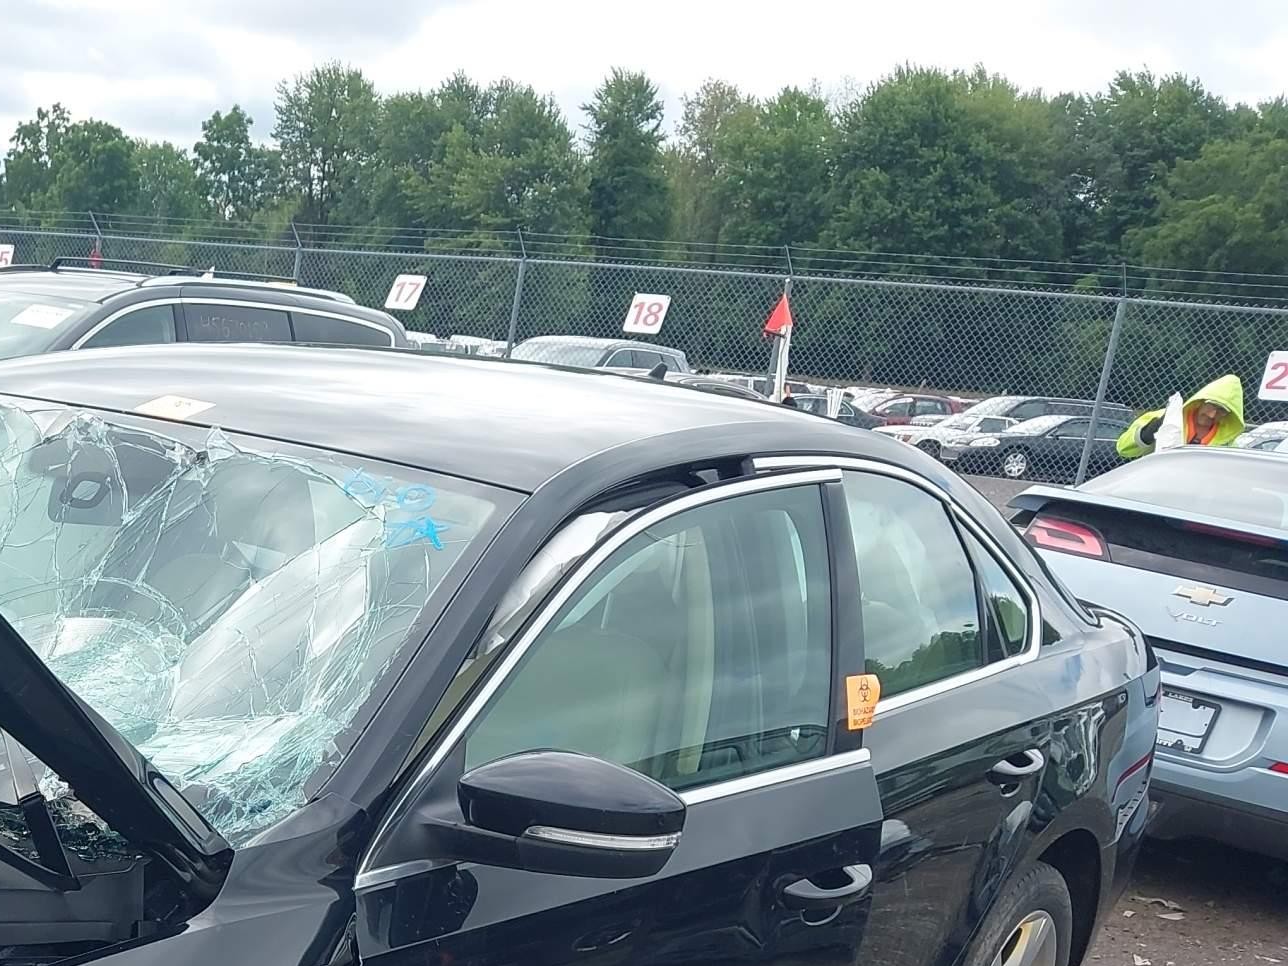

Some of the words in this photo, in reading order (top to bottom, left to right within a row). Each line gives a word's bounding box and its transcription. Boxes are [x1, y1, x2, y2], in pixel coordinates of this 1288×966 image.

[395, 281, 421, 303] 17
[633, 301, 664, 327] 18
[1166, 605, 1225, 628] VOLT
